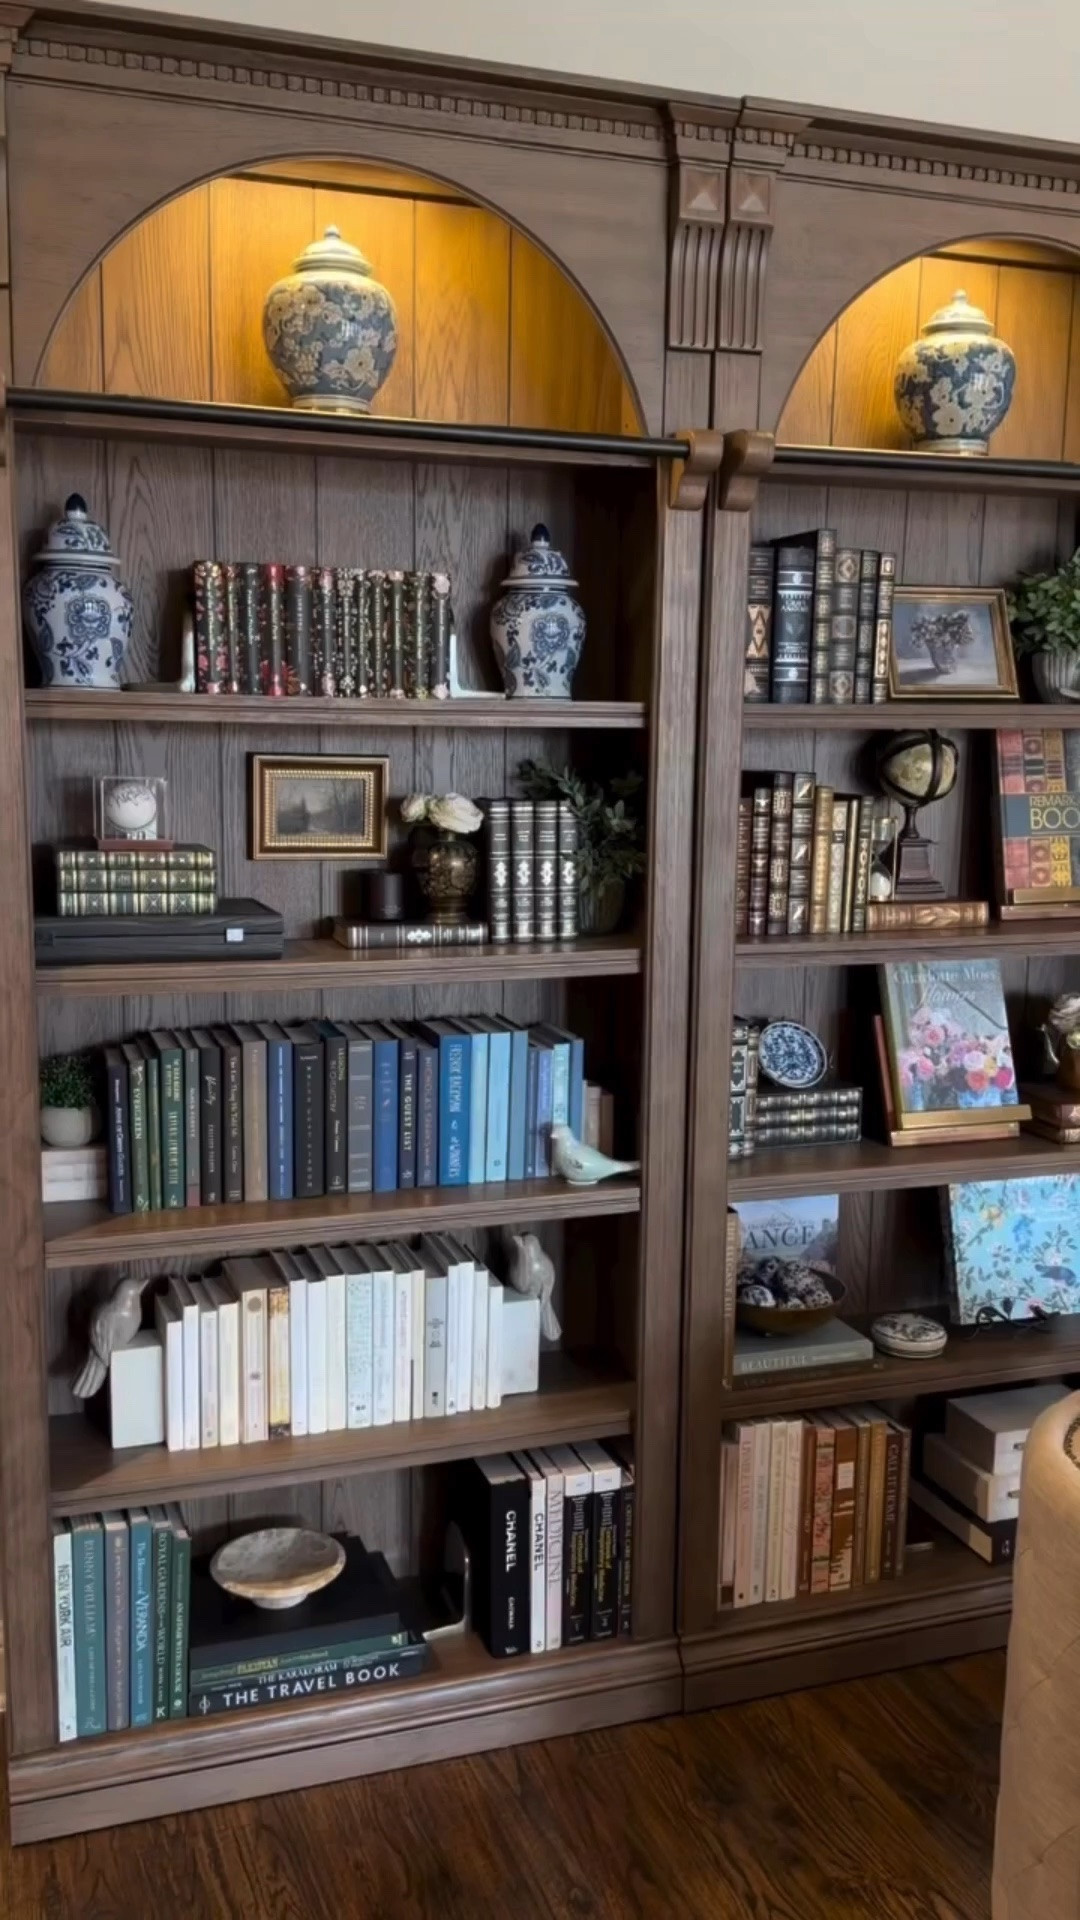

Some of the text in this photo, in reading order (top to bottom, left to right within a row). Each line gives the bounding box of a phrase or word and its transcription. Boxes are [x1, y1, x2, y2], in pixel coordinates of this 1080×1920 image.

[132, 1088, 143, 1140] EVERGREEN
[403, 1073, 412, 1151] THE GUEST LIST
[743, 1225, 815, 1249] ANCE
[887, 1443, 900, 1476] CALL
[157, 1532, 168, 1566] ROYAL
[506, 1510, 517, 1573] CHANEL
[533, 1512, 544, 1571] CHANEL
[58, 1564, 71, 1591] NEW
[59, 1592, 72, 1627] YORK
[60, 1628, 72, 1648] AIR
[222, 1688, 259, 1708] THE
[267, 1675, 337, 1700] TRAVEL
[345, 1663, 400, 1685] BOOK
